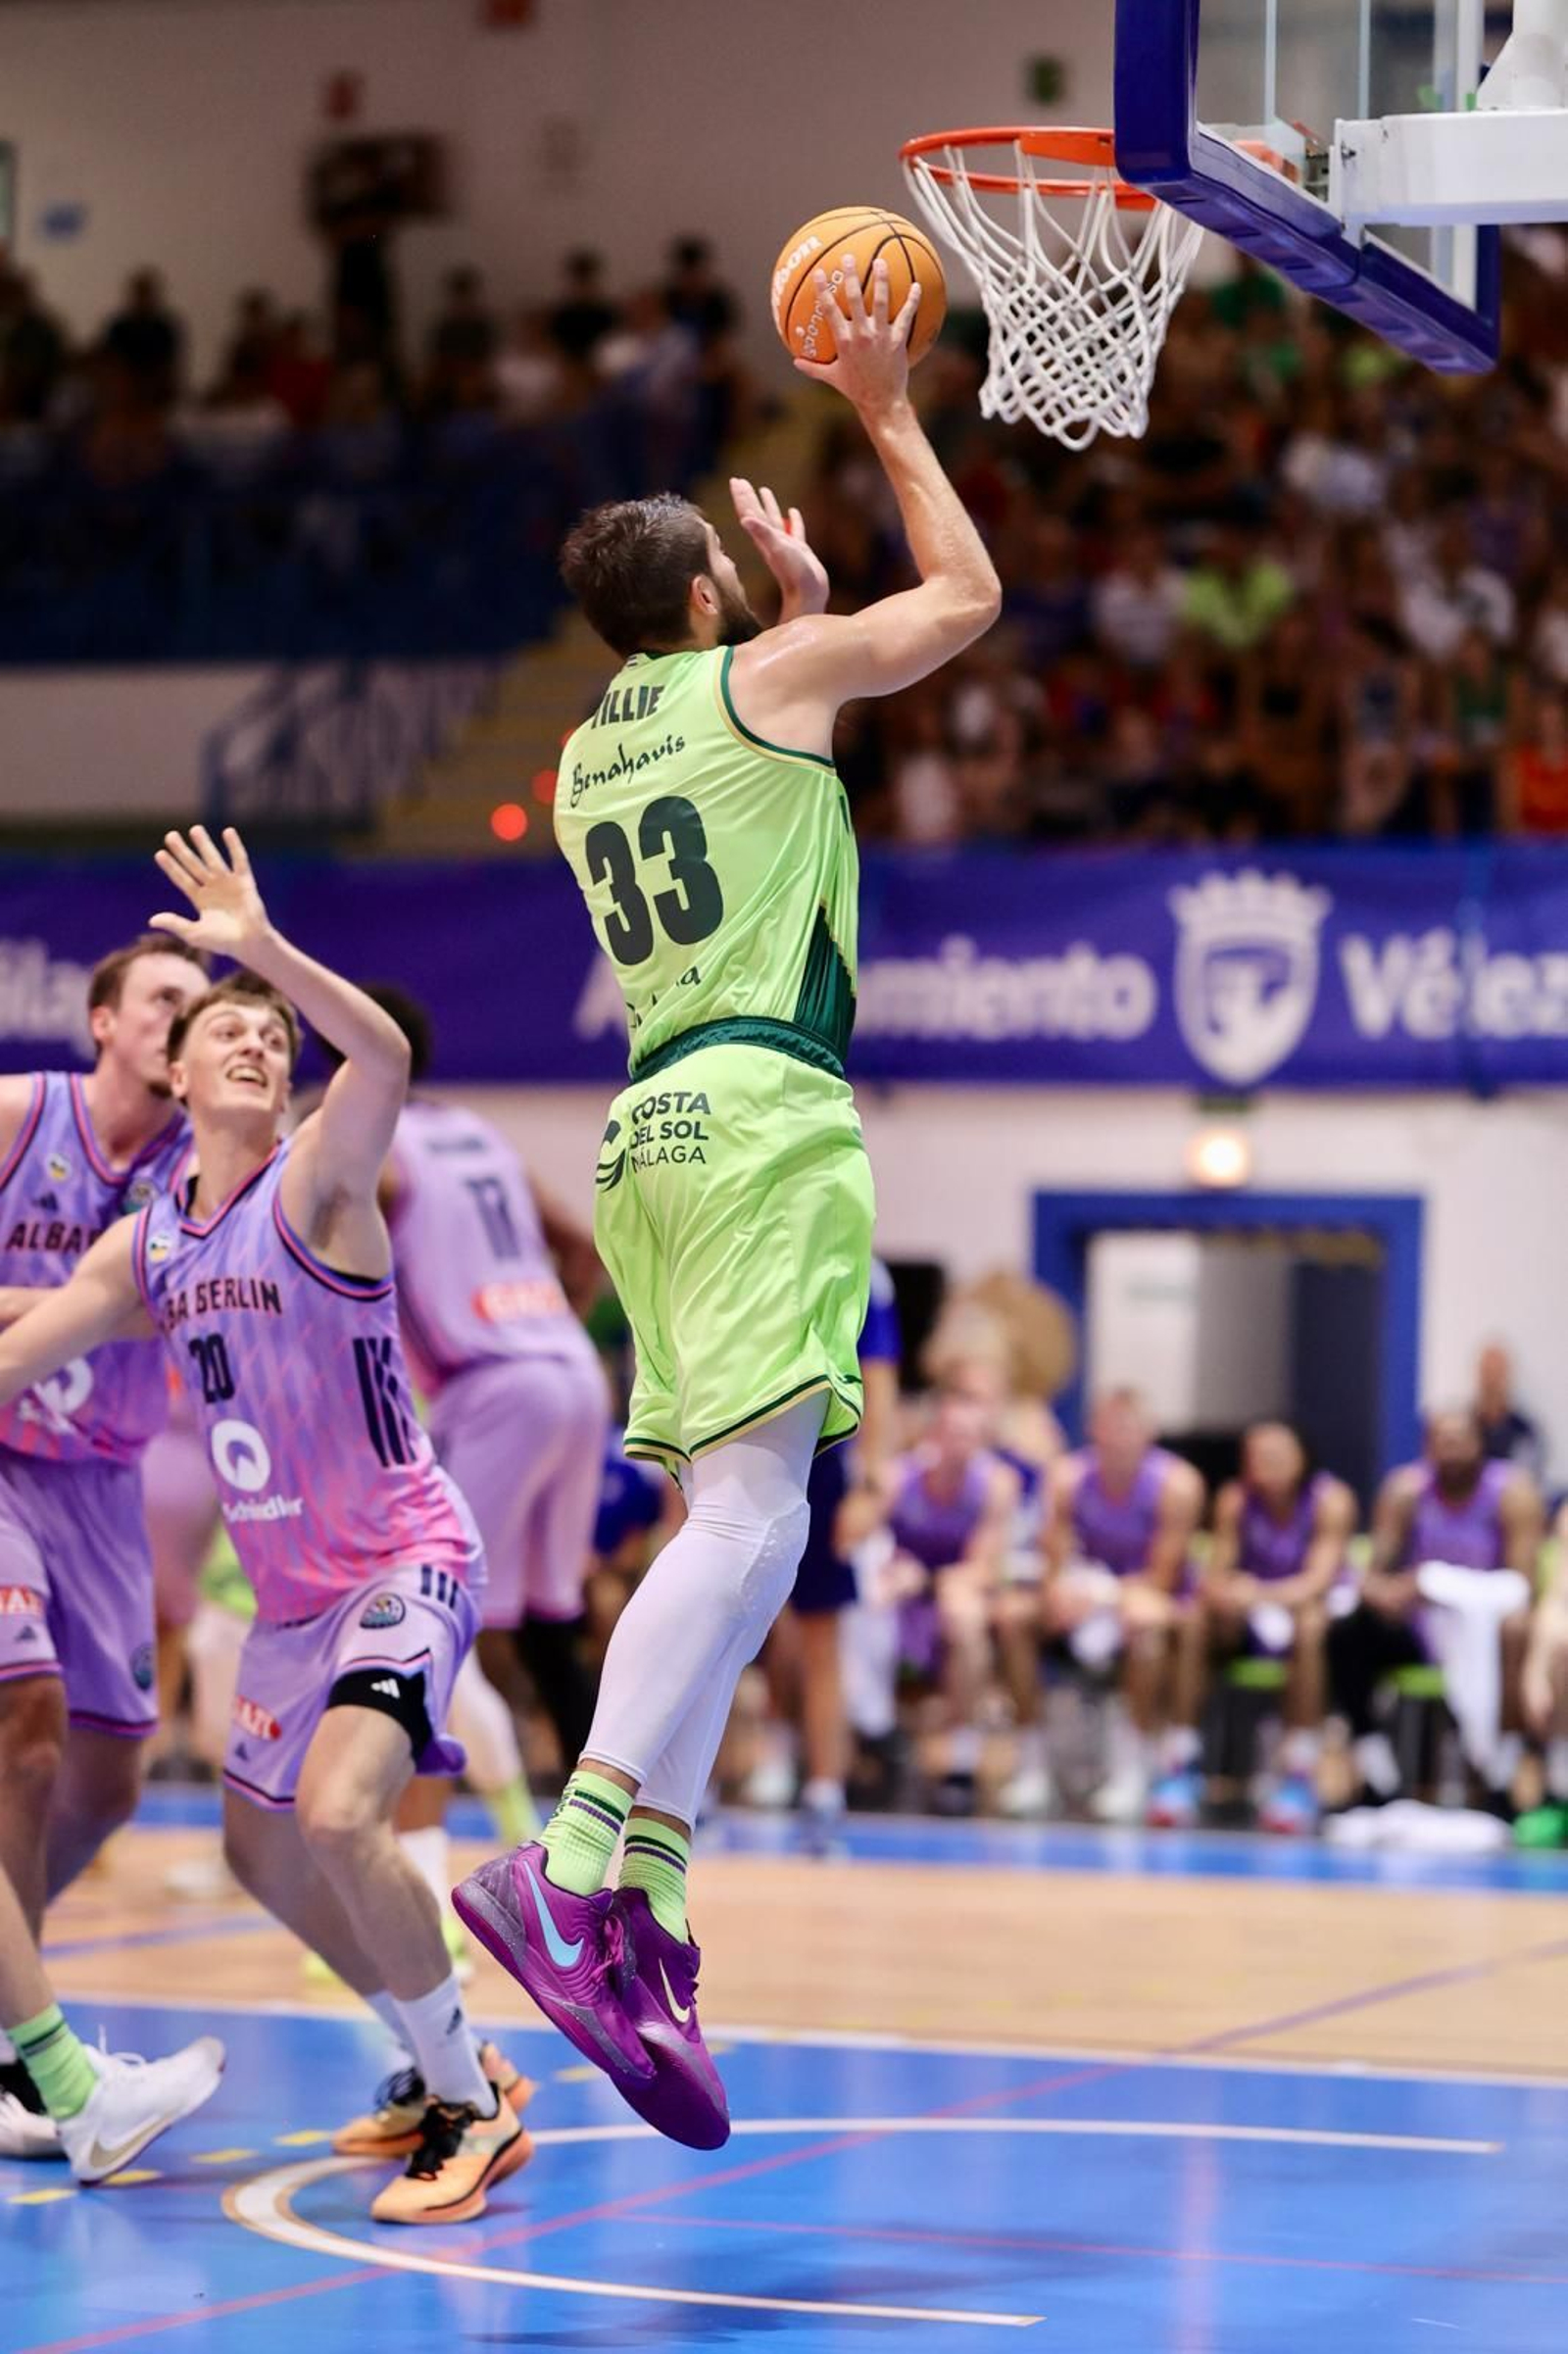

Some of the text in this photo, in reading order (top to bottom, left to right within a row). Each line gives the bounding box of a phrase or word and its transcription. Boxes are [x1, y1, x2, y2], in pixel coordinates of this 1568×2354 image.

[585, 796, 724, 966] 33
[632, 1092, 711, 1125] COSTA
[628, 1120, 710, 1150] DEL SOL
[5, 1221, 82, 1253] ALBA
[188, 1334, 235, 1404] 20
